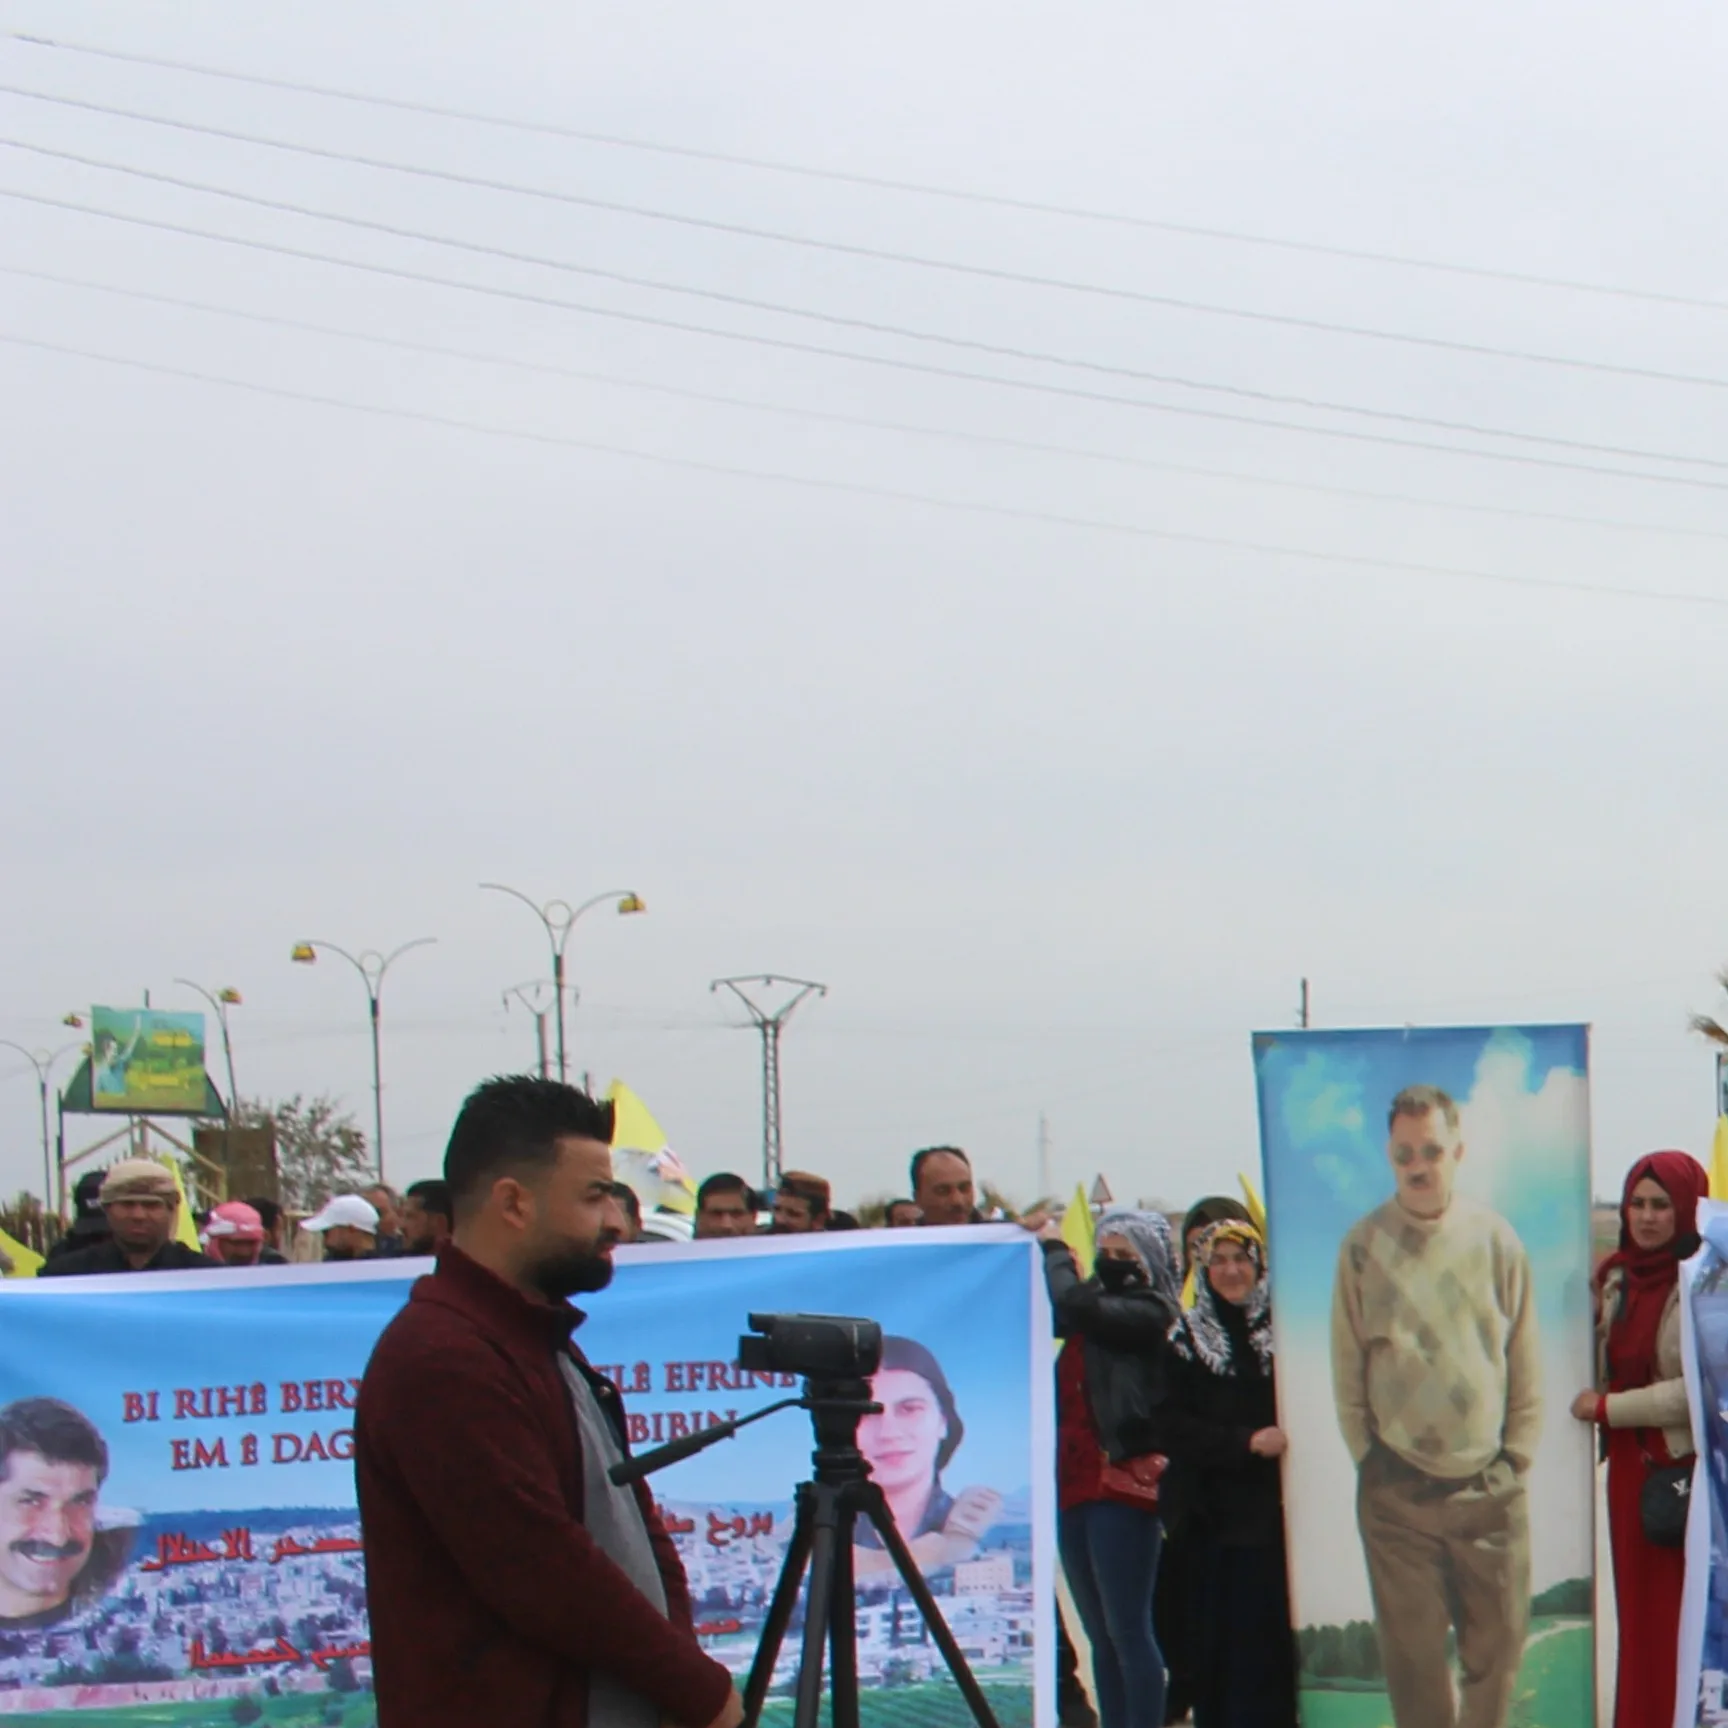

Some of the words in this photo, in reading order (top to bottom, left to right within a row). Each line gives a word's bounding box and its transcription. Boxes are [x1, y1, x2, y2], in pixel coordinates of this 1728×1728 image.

[122, 1389, 160, 1423] BI
[169, 1435, 230, 1471] EM
[270, 1428, 356, 1465] DAG
